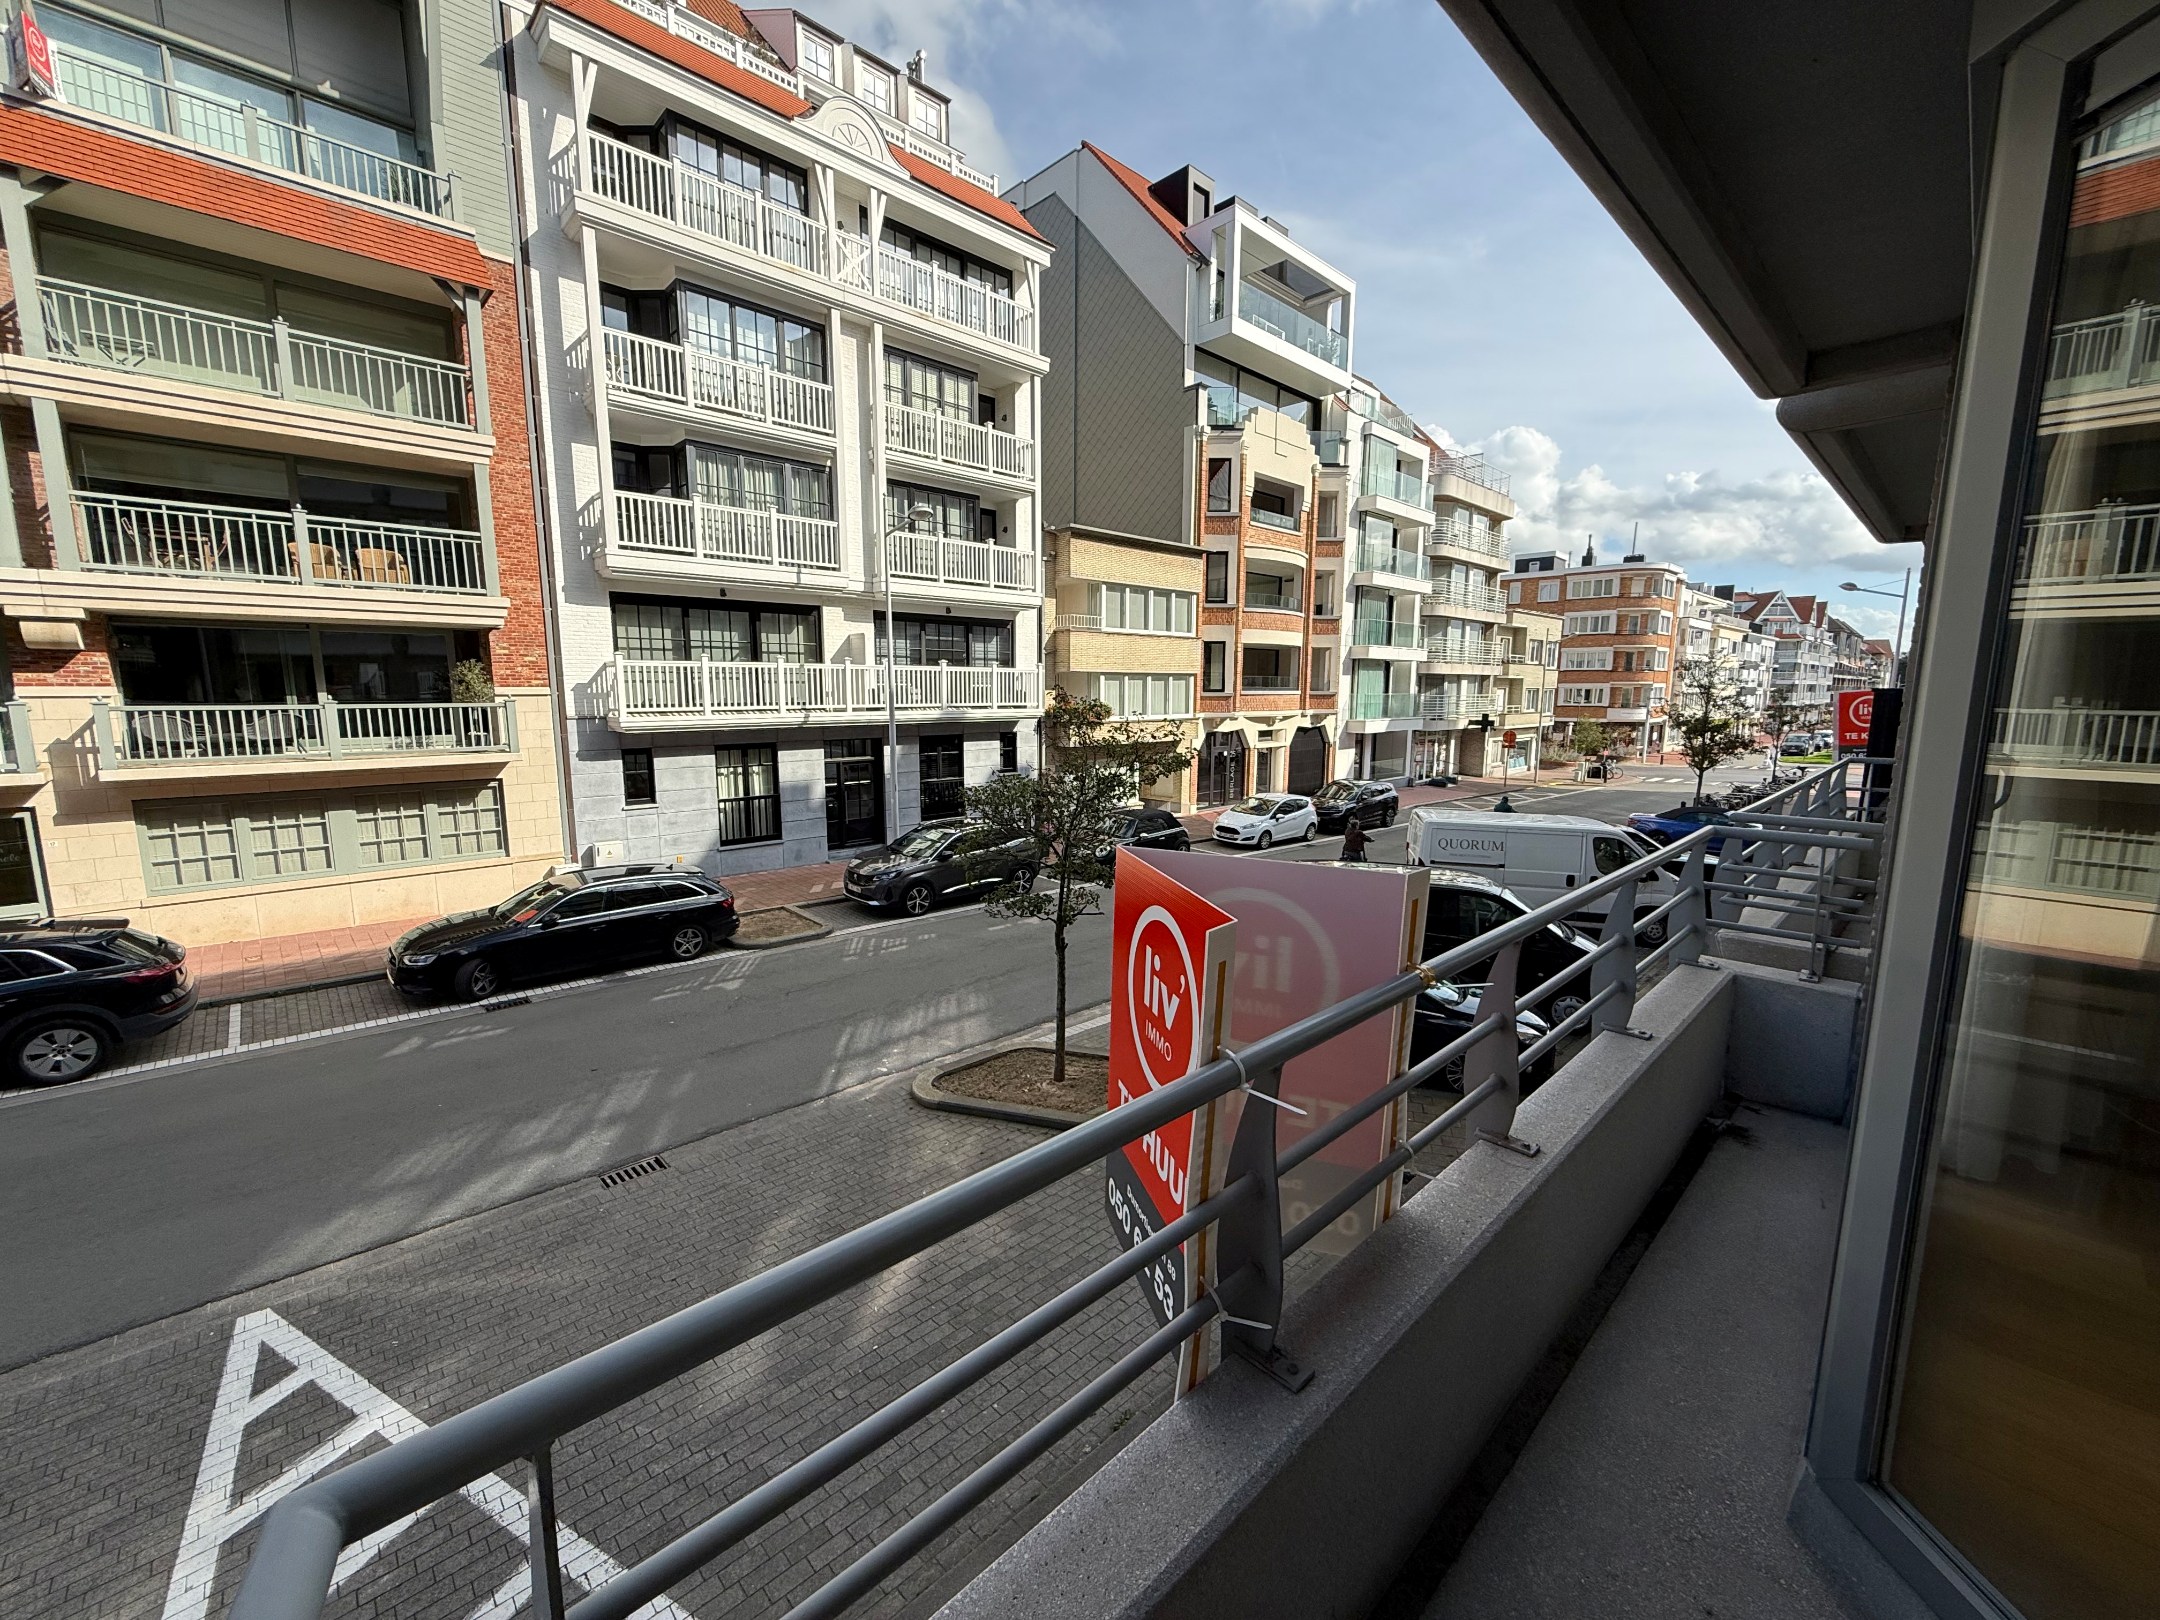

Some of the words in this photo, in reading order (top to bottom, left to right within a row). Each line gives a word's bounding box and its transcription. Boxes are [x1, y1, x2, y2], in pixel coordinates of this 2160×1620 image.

[1844, 732, 1859, 740] TE
[1437, 837, 1504, 852] QUORUM
[1145, 1019, 1172, 1062] IMMO
[1108, 1177, 1131, 1235] 050
[1153, 1264, 1174, 1321] 53
[1167, 1258, 1176, 1281] 89
